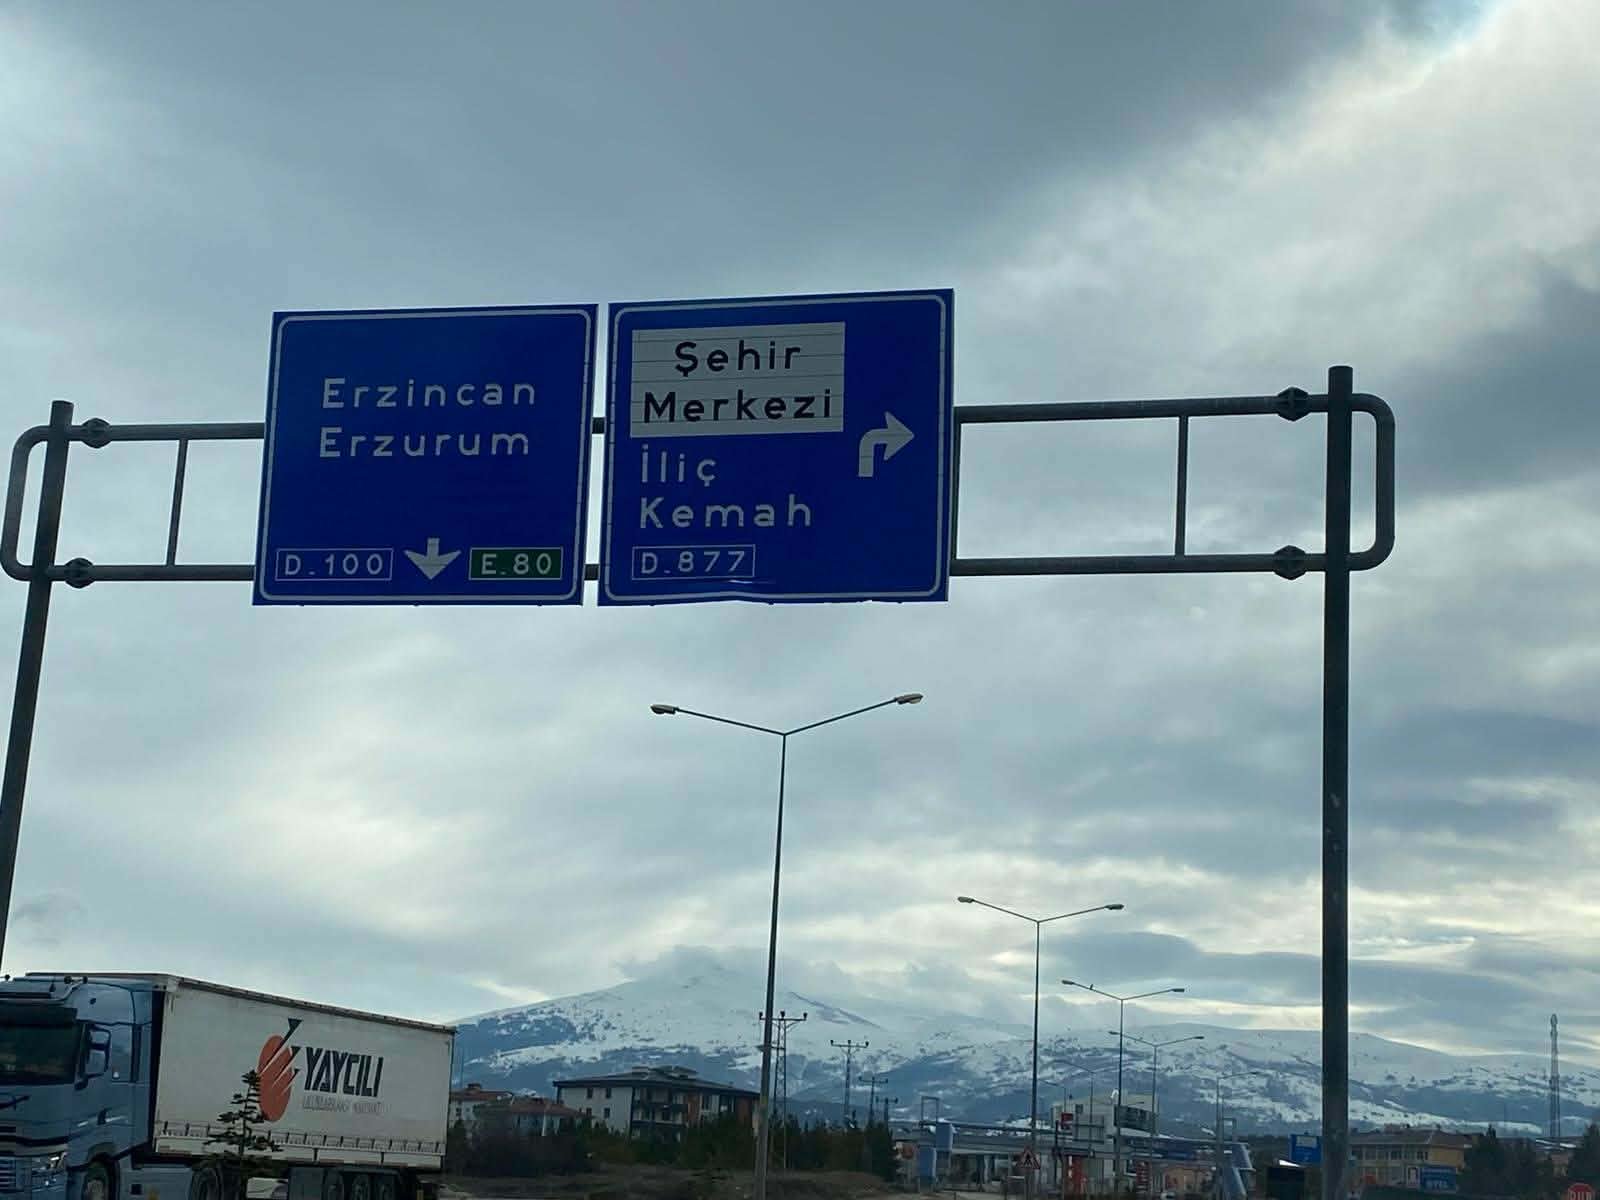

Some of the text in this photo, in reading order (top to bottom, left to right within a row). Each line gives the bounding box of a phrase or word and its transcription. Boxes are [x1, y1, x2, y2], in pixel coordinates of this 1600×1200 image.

[674, 339, 801, 378] Şehir
[322, 377, 536, 409] Erzincan
[643, 388, 832, 423] Merkezi
[319, 426, 530, 458] Erzurum
[641, 443, 717, 487] İliç
[639, 493, 812, 529] Kemah
[284, 553, 384, 576] D.100
[481, 552, 552, 576] E.80
[641, 550, 746, 575] D.877
